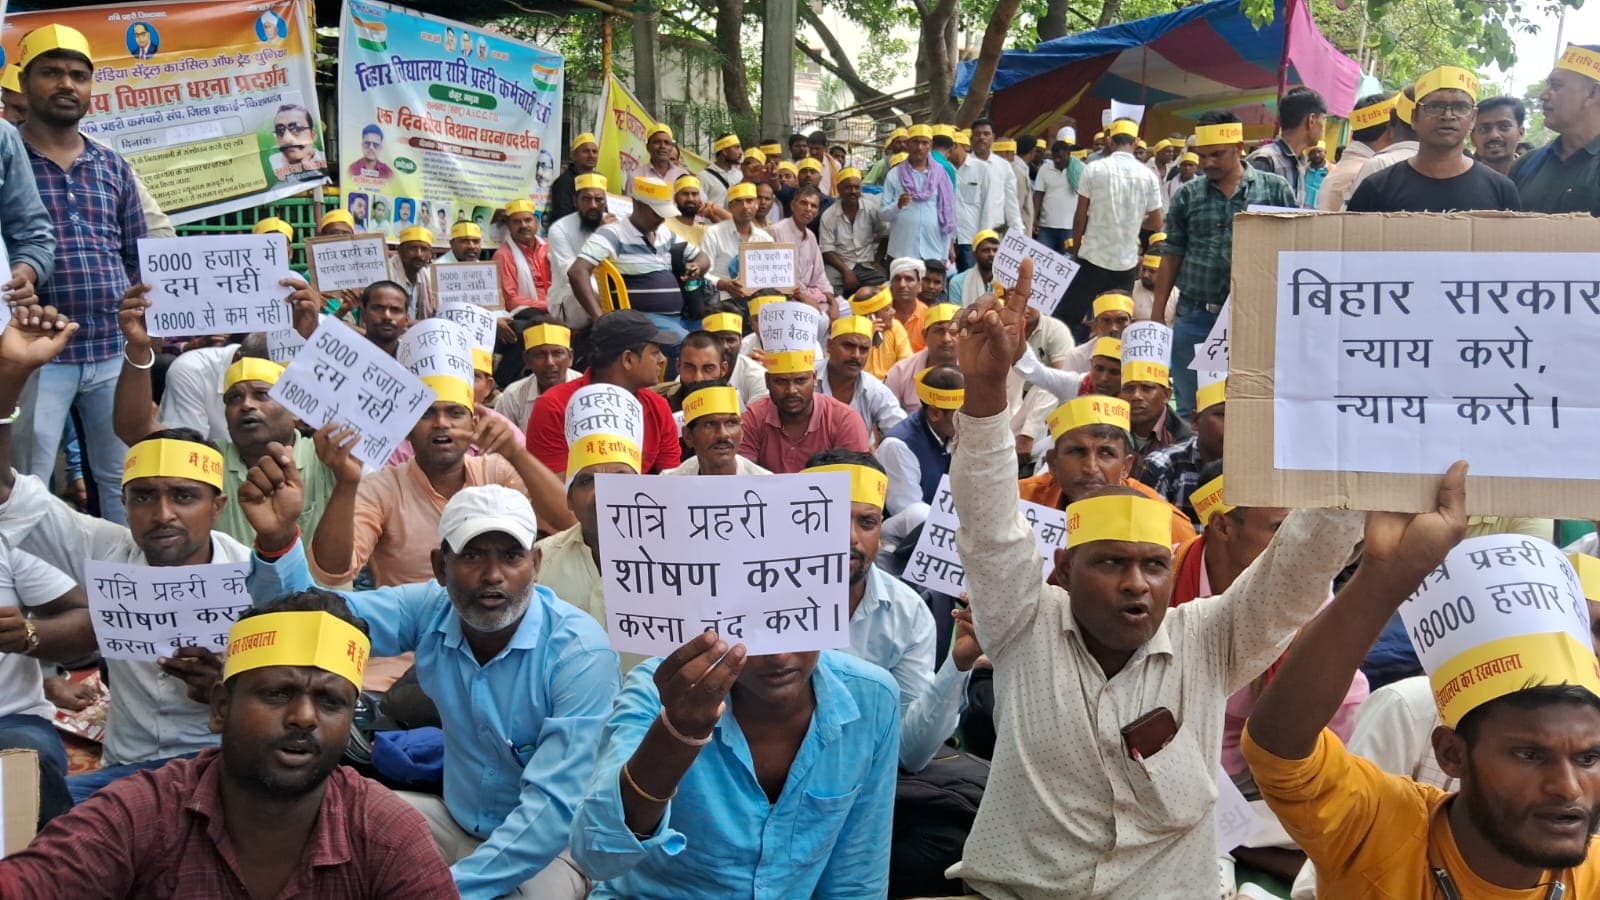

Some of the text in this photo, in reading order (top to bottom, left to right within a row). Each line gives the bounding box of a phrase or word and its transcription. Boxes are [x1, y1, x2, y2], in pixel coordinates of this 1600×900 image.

[212, 54, 234, 67] ऑफ
[445, 57, 468, 86] रात्रि
[471, 64, 498, 95] प्रहरी
[115, 83, 181, 111] विशाल
[188, 75, 230, 100] धरना
[234, 64, 288, 95] प्रदर्शन
[101, 117, 125, 133] प्रहरी
[187, 104, 211, 118] जिला
[376, 106, 393, 125] एक
[148, 239, 278, 273] 5000 हजार में
[317, 243, 378, 262] रात्रि प्रहरी को
[1005, 235, 1027, 255] रात्रि
[1055, 262, 1073, 280] को
[161, 267, 262, 298] दम नहीं
[1287, 268, 1600, 317] बिहार सरकार
[153, 311, 195, 331] 18000
[202, 301, 216, 327] से
[223, 306, 248, 326] कम
[417, 325, 452, 349] प्रहरी
[1342, 325, 1547, 374] न्याय करो,
[315, 332, 428, 413] 5000 हजार में
[279, 380, 319, 415] 18000
[322, 403, 340, 425] से
[313, 357, 400, 425] दम नहीं
[579, 387, 622, 411] प्रहरी
[1333, 395, 1429, 424] न्याय
[606, 485, 833, 541] रात्रि प्रहरी को
[611, 545, 848, 597] शोषण करना
[914, 550, 966, 587] भुगत
[1466, 540, 1546, 571] प्रहरी
[94, 573, 138, 601] रात्रि
[152, 573, 207, 602] प्रहरी
[98, 603, 254, 631] शोषण कर
[615, 612, 685, 643] करना
[1413, 595, 1476, 654] 18000
[1485, 581, 1566, 615] हजार
[104, 636, 156, 655] करना
[1474, 653, 1524, 682] रखवाला
